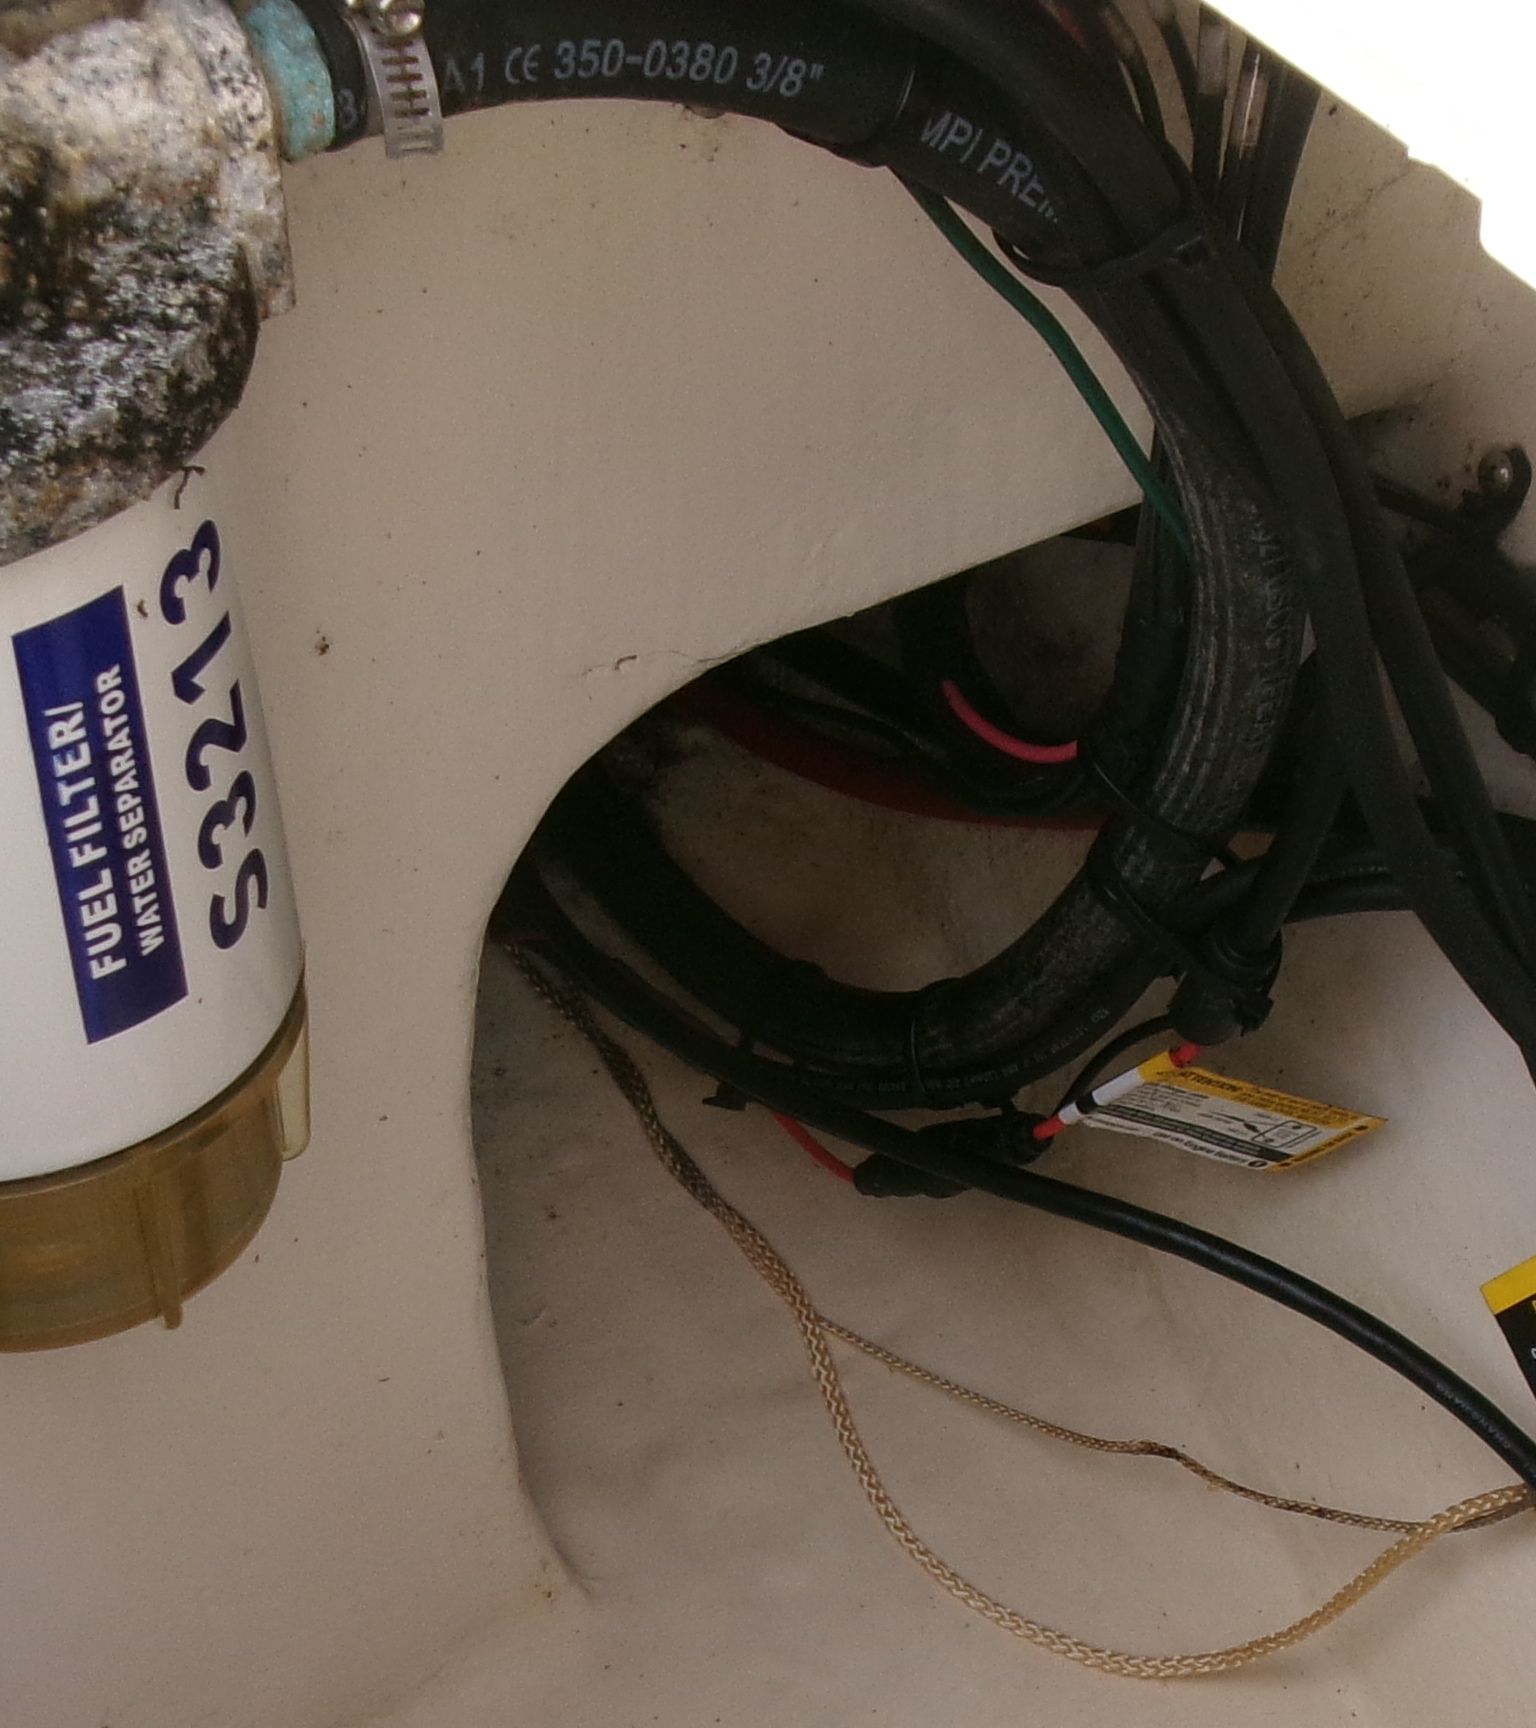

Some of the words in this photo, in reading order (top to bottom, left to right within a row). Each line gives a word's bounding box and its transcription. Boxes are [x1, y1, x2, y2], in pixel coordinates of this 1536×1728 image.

[553, 38, 739, 86] 350-0380
[746, 56, 825, 98] 3/8"
[42, 701, 108, 869] FILTER/
[95, 663, 148, 850] SEPARATOR
[159, 519, 269, 950] S3213
[77, 867, 128, 980] FUEL
[126, 848, 165, 957] WATER
